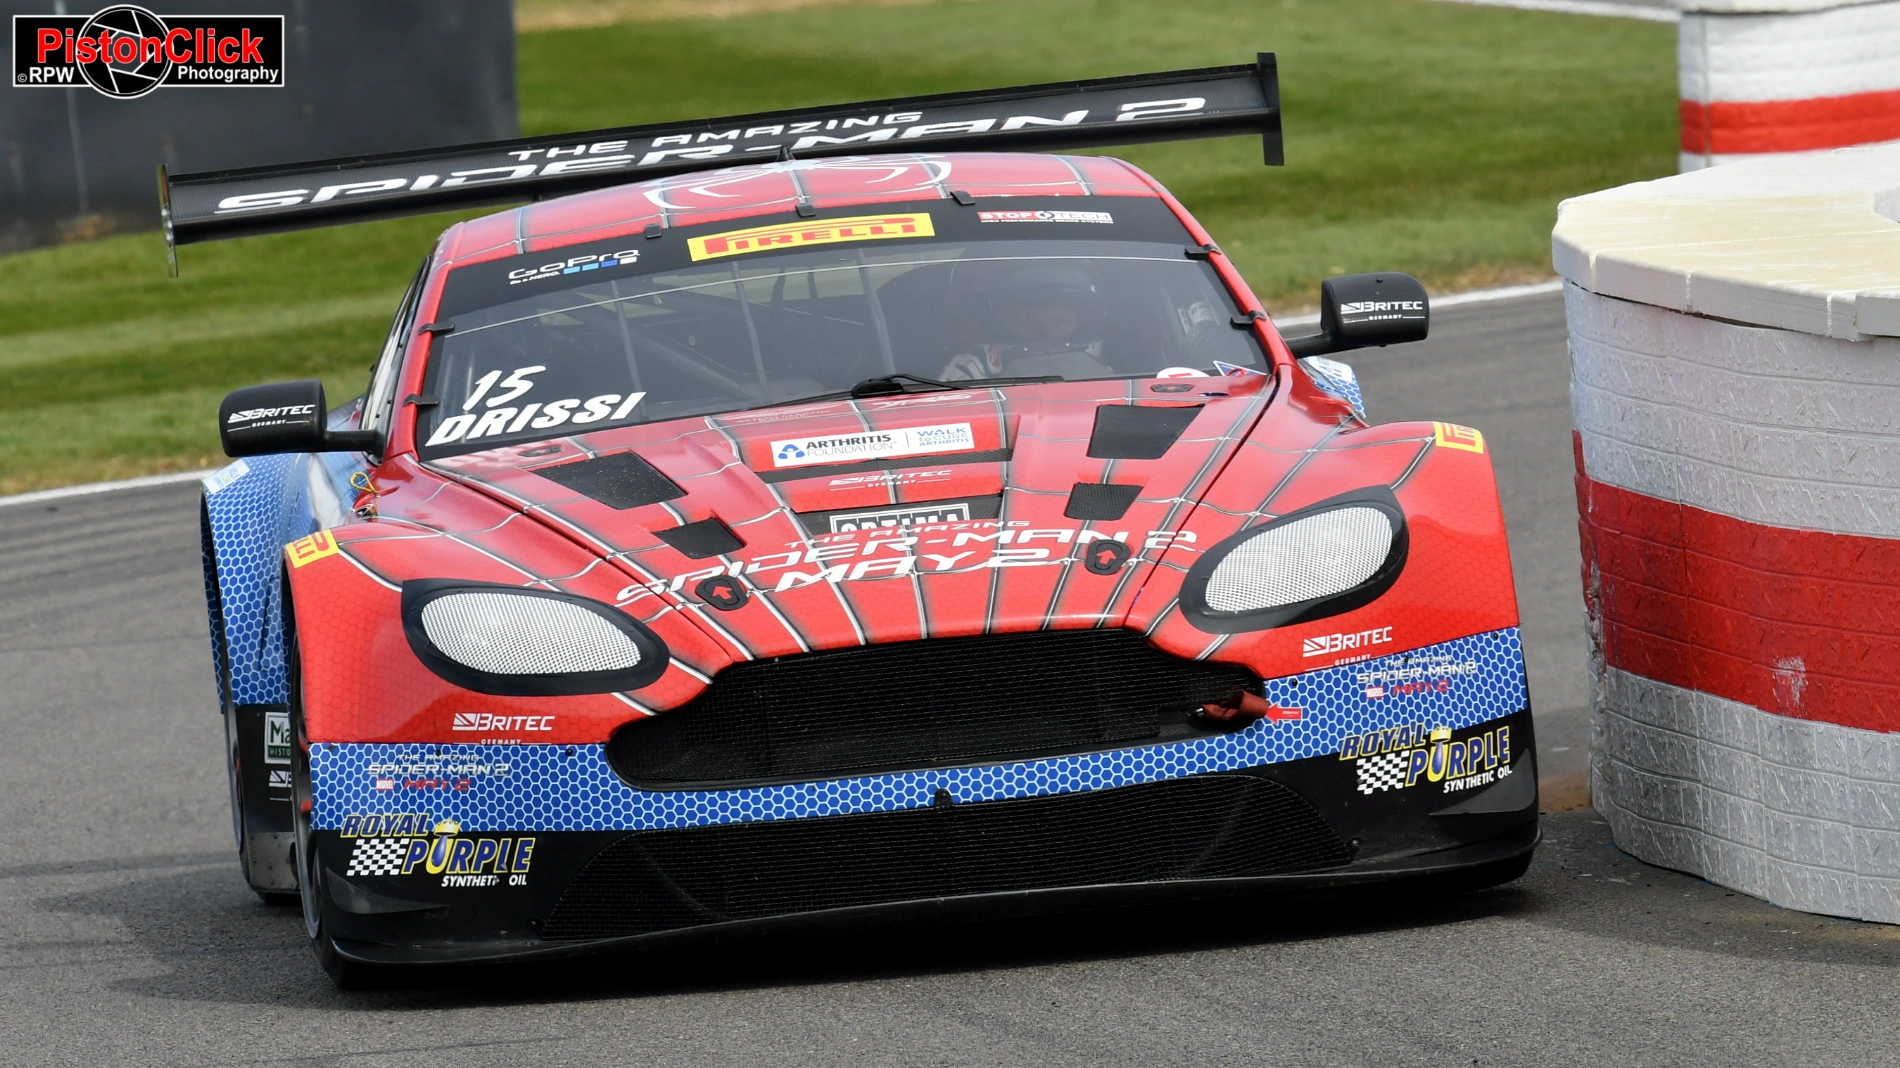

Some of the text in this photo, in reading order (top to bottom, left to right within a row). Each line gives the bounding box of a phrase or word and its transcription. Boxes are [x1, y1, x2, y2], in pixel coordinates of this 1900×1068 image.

[508, 111, 923, 161] THE AMAZING
[213, 96, 1207, 214] SPIDER-MAN 2
[704, 217, 916, 254] PIRELLI
[508, 249, 641, 279] GoPro
[1360, 301, 1423, 312] BRITEC
[462, 365, 547, 410] 15
[250, 404, 316, 420] BRITEC
[425, 391, 647, 447] DRISSI
[251, 419, 287, 428] GERMANY
[917, 427, 967, 437] WALK
[806, 434, 892, 450] ARTHRITIS
[919, 438, 970, 446] ARTHRITIS
[934, 433, 969, 441] CURE
[807, 442, 893, 457] FOUNDATION
[859, 469, 953, 482] BRITEC
[784, 520, 1031, 548] THE AMAZING
[616, 529, 1200, 600] SPIDER-MAN 2
[775, 548, 1052, 592] MAY 2
[1324, 626, 1393, 653] BRITEC
[1334, 653, 1372, 667] GERMANY
[1356, 659, 1478, 684] SPIDER-MAN 2
[1393, 680, 1434, 696] MAY
[1436, 679, 1450, 693] 2
[475, 713, 556, 731] BRITEC
[480, 738, 522, 746] GERMANY
[1339, 723, 1427, 761] ROYAL
[397, 753, 419, 761] THE
[1405, 725, 1511, 788] PURPLE
[367, 763, 511, 777] SPIDER-MAN 2
[1443, 764, 1513, 794] SYNTHETIC OIL
[403, 778, 471, 791] MAY 2
[340, 813, 430, 838] ROYAL
[401, 837, 536, 874] PURPLE
[508, 874, 527, 886] OIL
